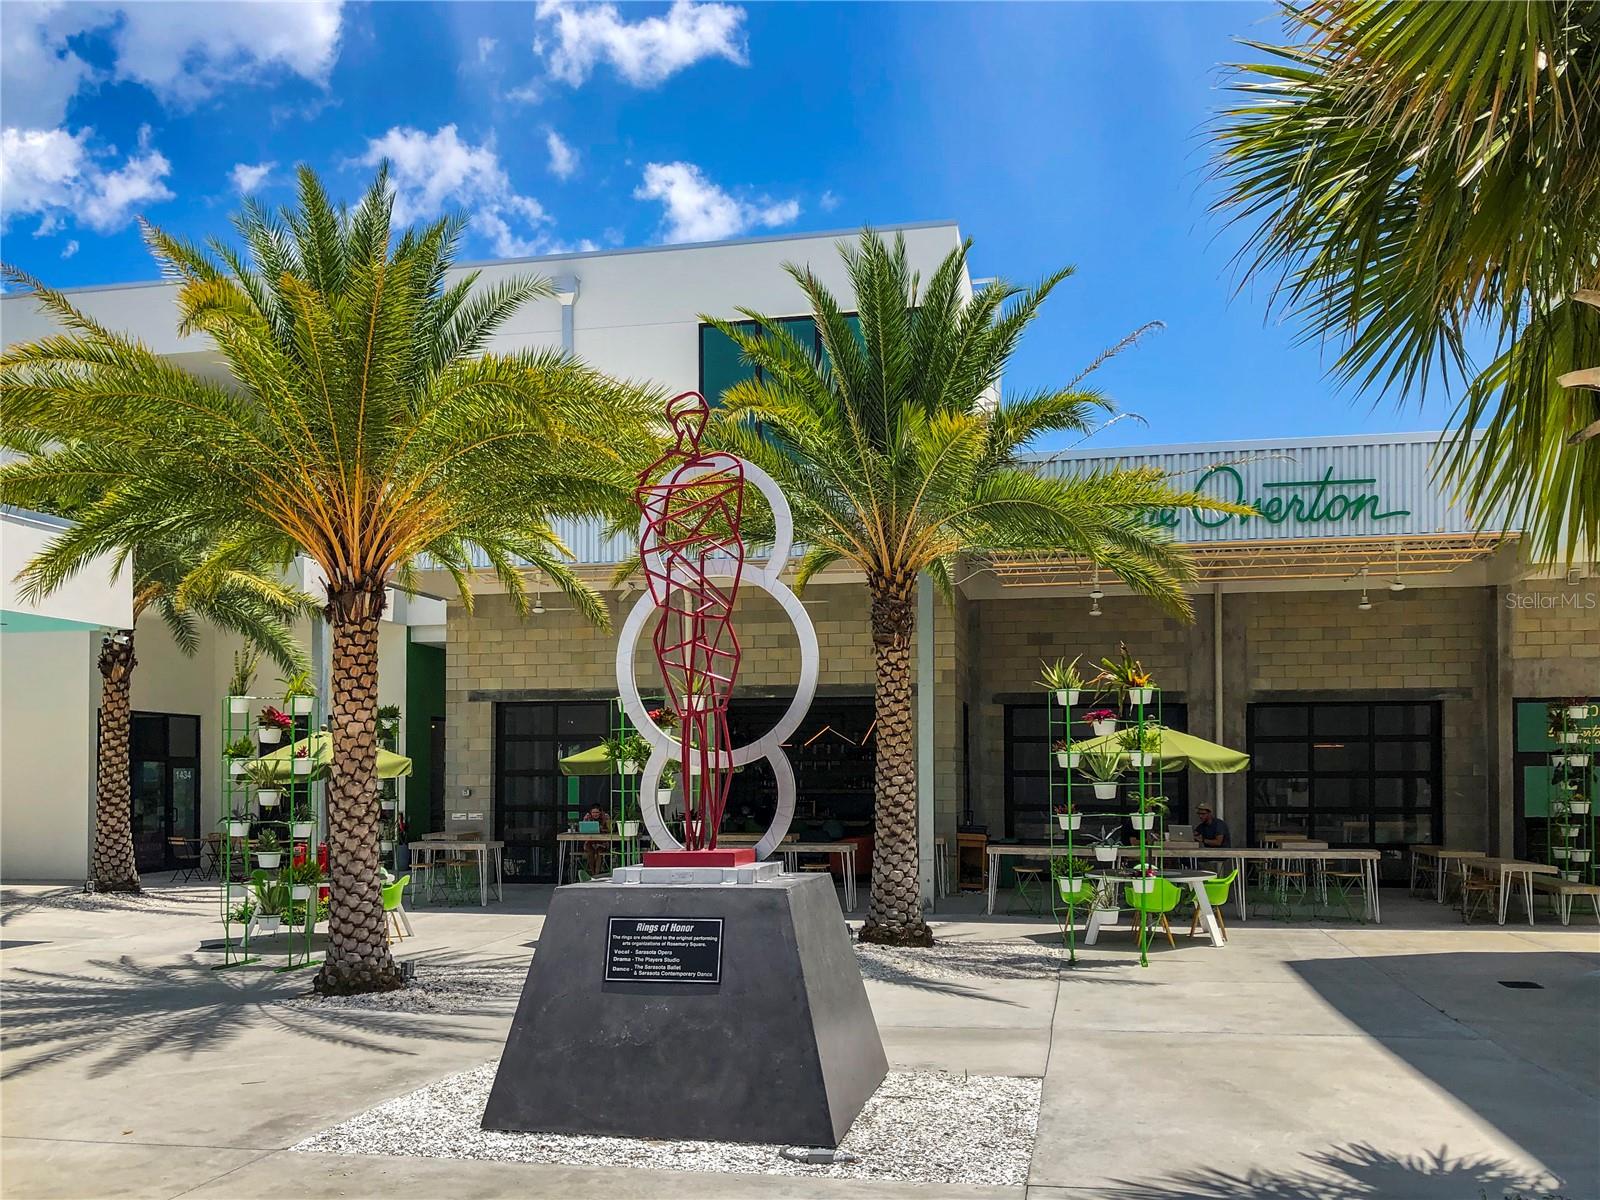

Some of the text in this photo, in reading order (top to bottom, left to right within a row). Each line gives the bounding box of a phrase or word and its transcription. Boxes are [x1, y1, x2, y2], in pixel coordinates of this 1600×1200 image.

[176, 770, 192, 780] 1434
[636, 922, 695, 933] Rings of Honor
